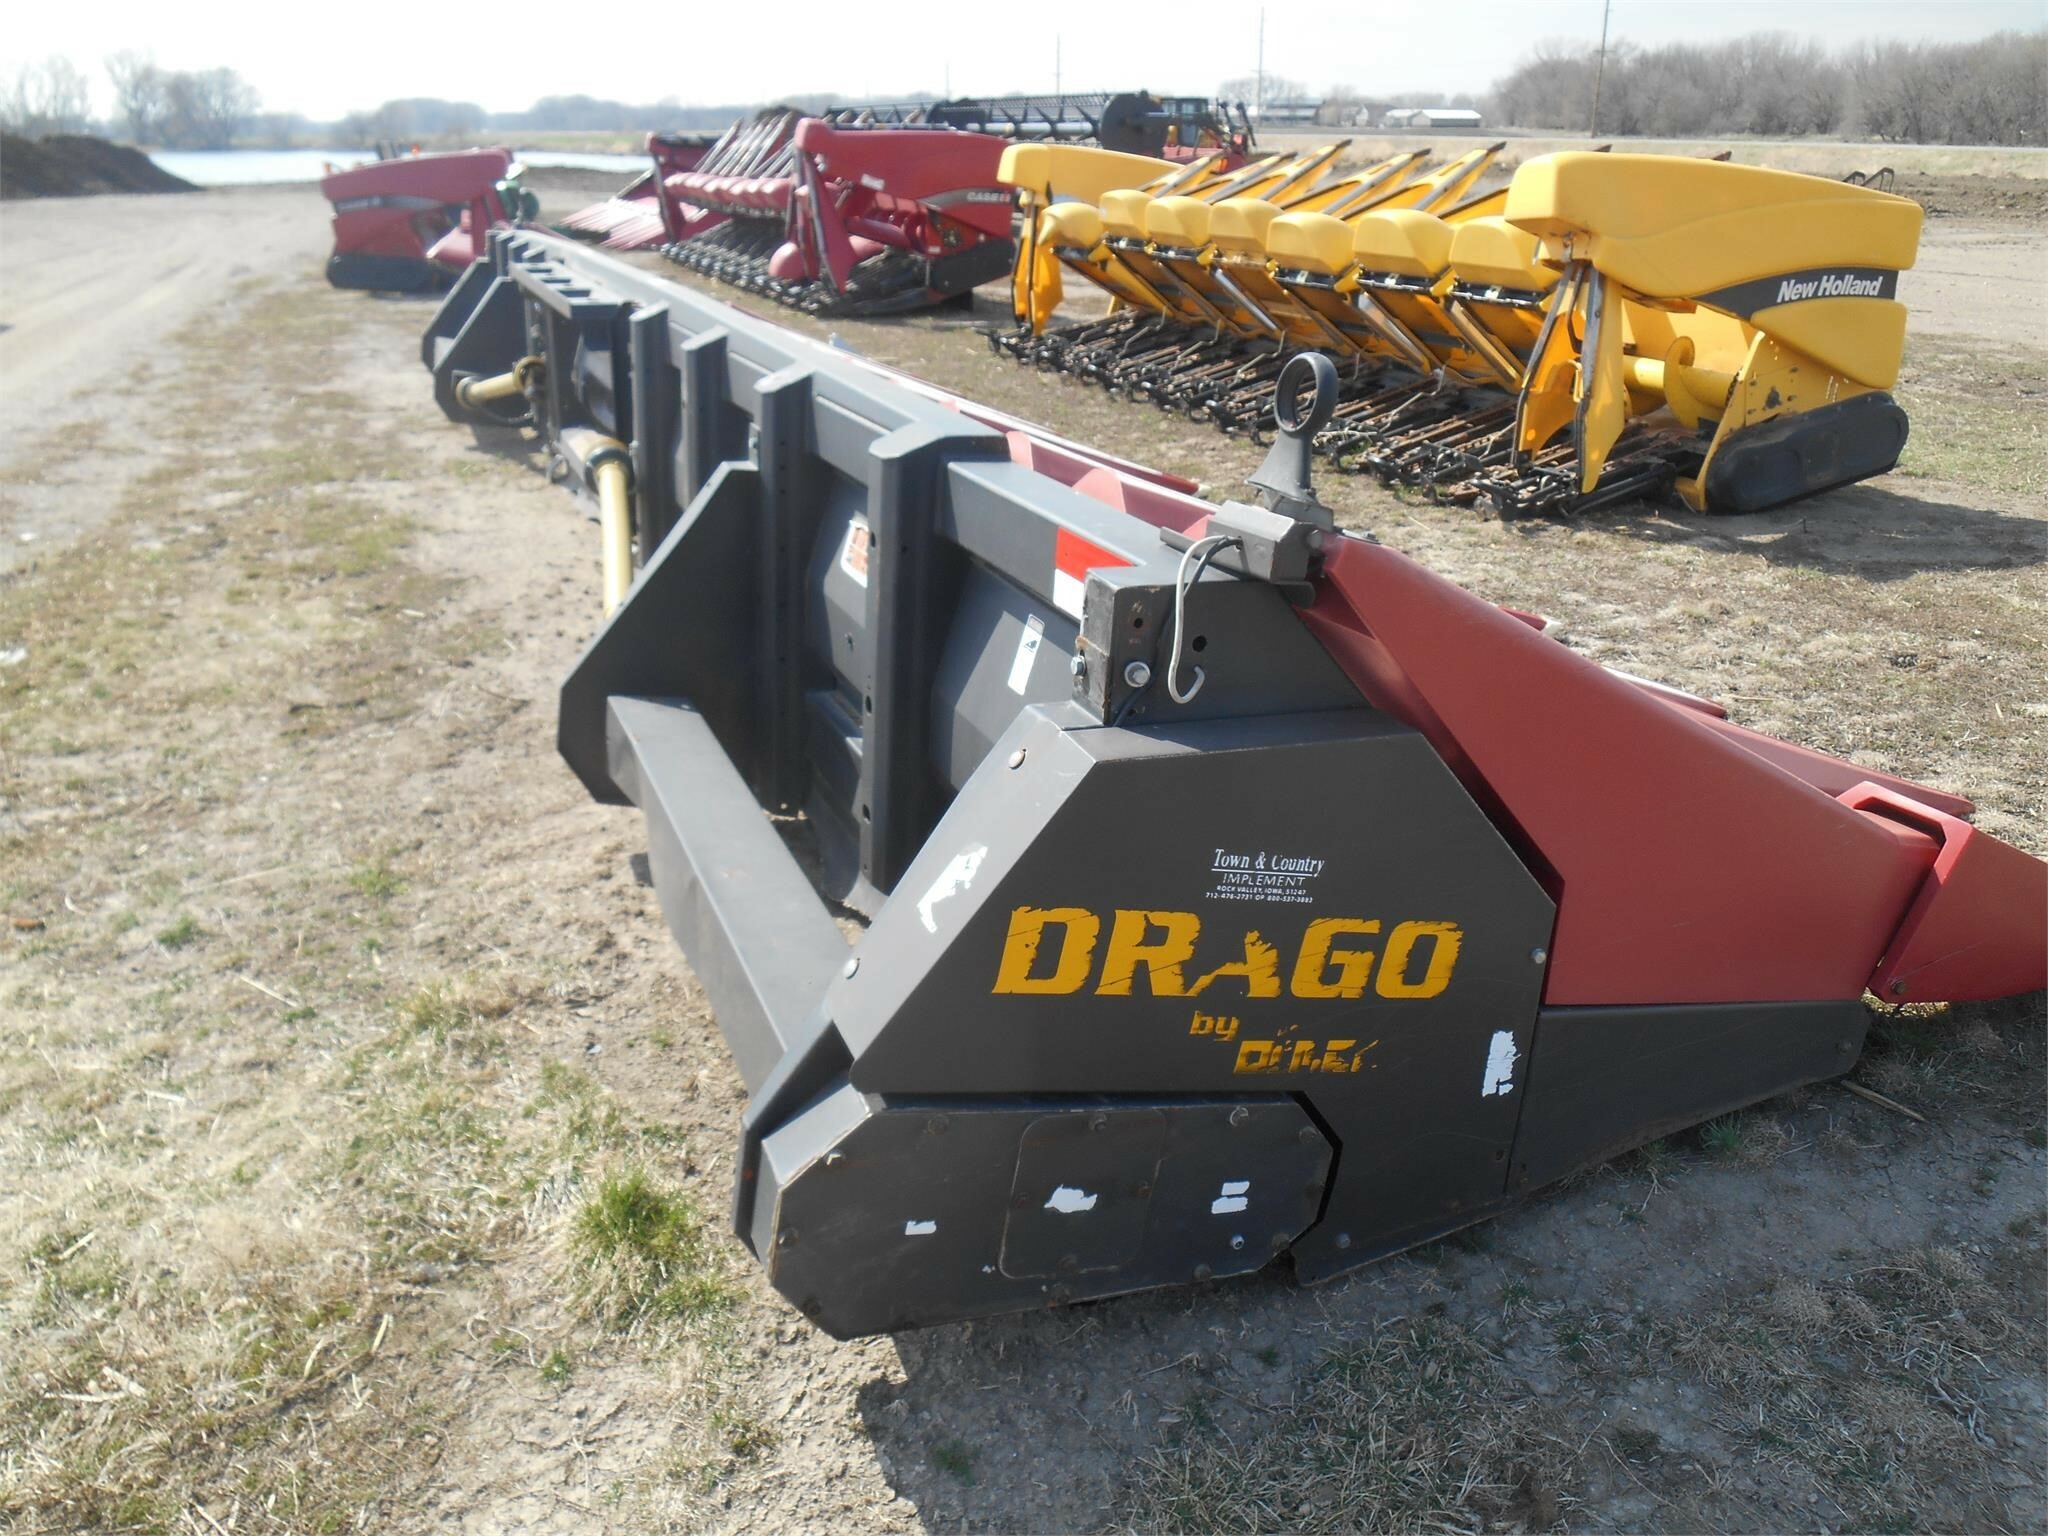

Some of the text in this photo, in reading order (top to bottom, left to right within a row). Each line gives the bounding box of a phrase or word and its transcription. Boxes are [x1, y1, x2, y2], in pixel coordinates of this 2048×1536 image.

[1776, 274, 1884, 303] New Holland
[1214, 848, 1325, 878] Town & Country
[1222, 873, 1306, 887] IMPLEMENT
[991, 906, 1465, 999] DRAGO
[1189, 1010, 1240, 1042] by
